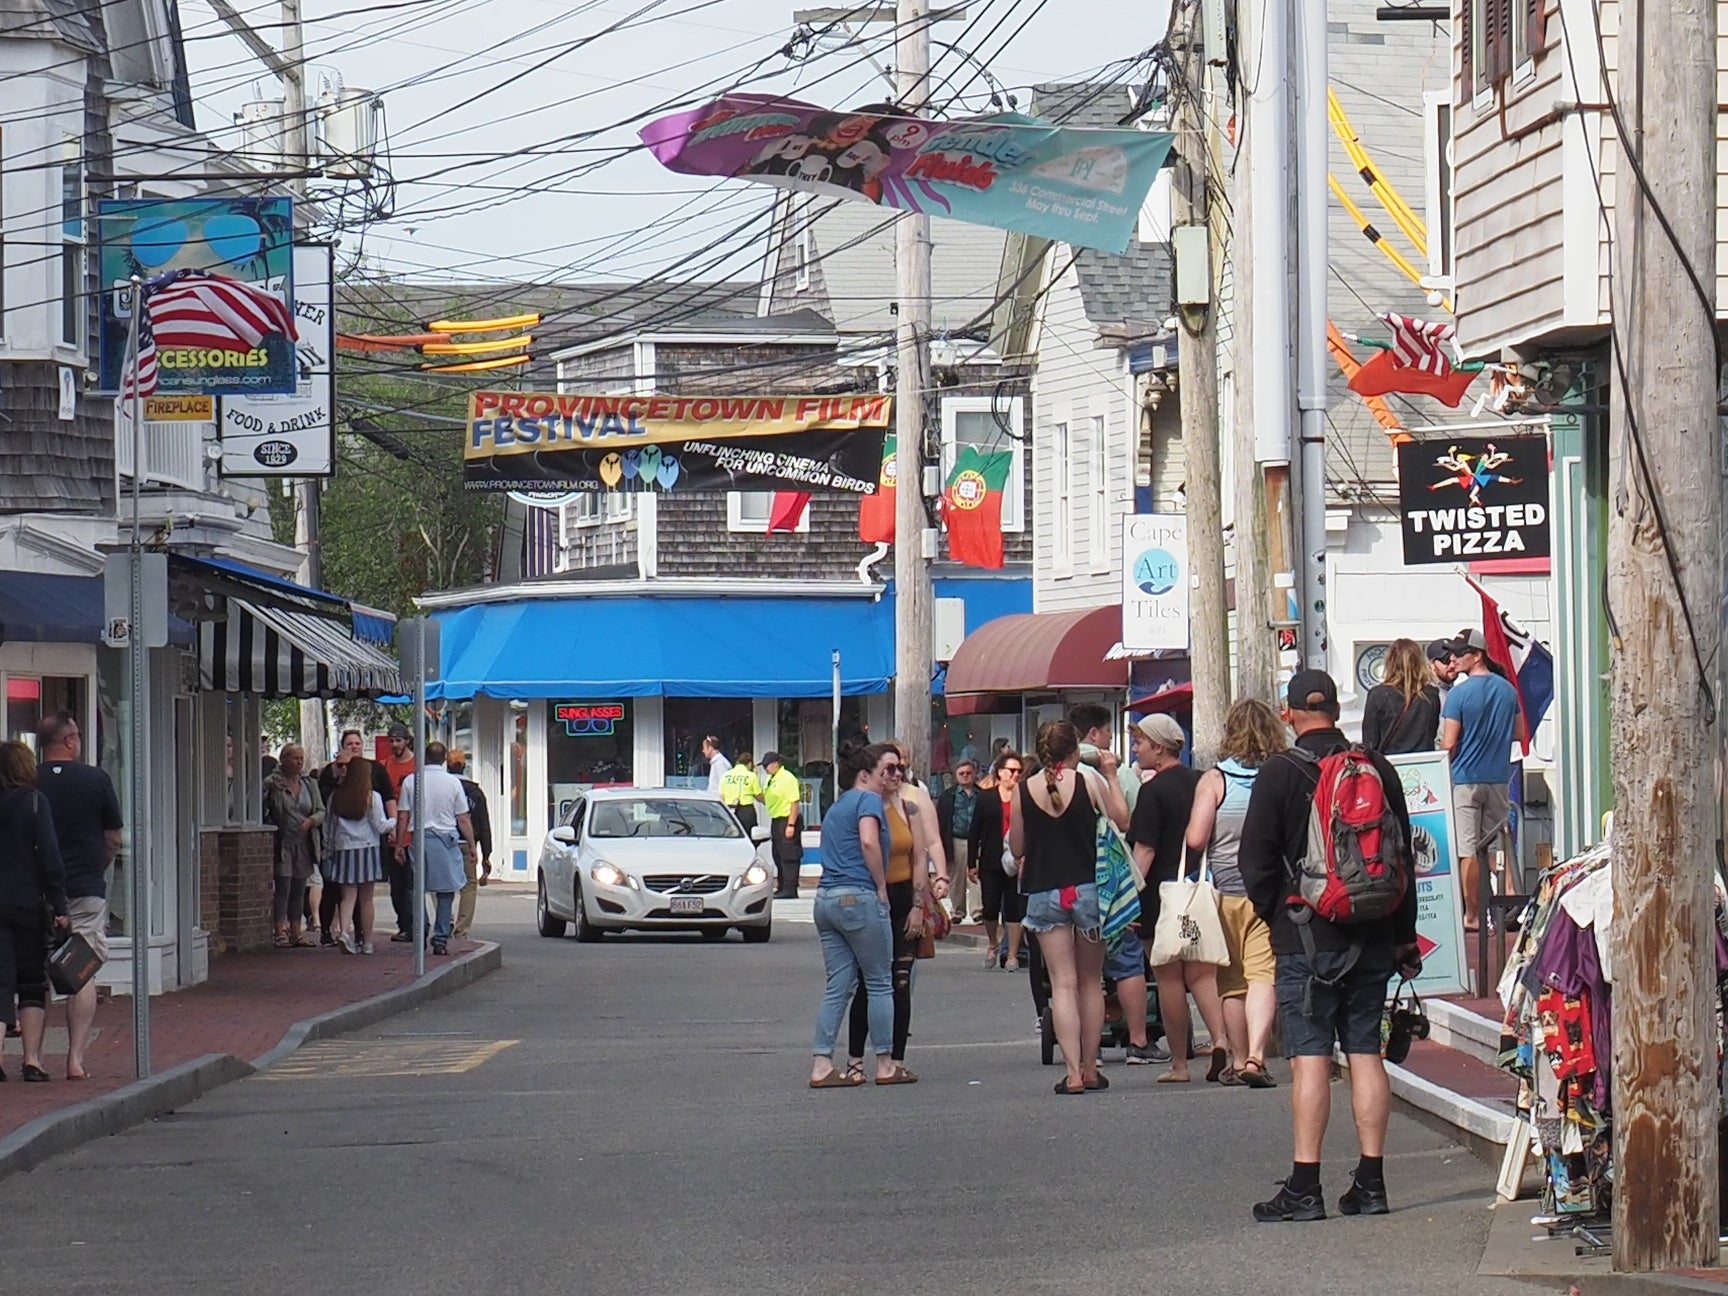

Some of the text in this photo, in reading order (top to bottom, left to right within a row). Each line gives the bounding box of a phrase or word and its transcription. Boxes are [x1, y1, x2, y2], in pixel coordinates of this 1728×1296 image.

[1030, 185, 1097, 209] Commercial
[145, 401, 210, 414] FIREPLACE
[225, 406, 327, 434] FOOD & DRINK
[474, 391, 885, 424] PROVINCETOWN FILM
[472, 410, 648, 449] FESTIVAL
[260, 443, 292, 454] SINCE
[683, 441, 829, 474] UNFLINCHING CINEMA
[714, 455, 876, 495] FOR UNCOMMON BIRDS
[1407, 503, 1546, 533] TWISTED
[1130, 521, 1182, 546] Cape
[1432, 529, 1526, 556] PIZZA
[1137, 557, 1177, 580] Art
[1130, 599, 1181, 619] Tiles
[557, 706, 622, 718] SUNGLASSES
